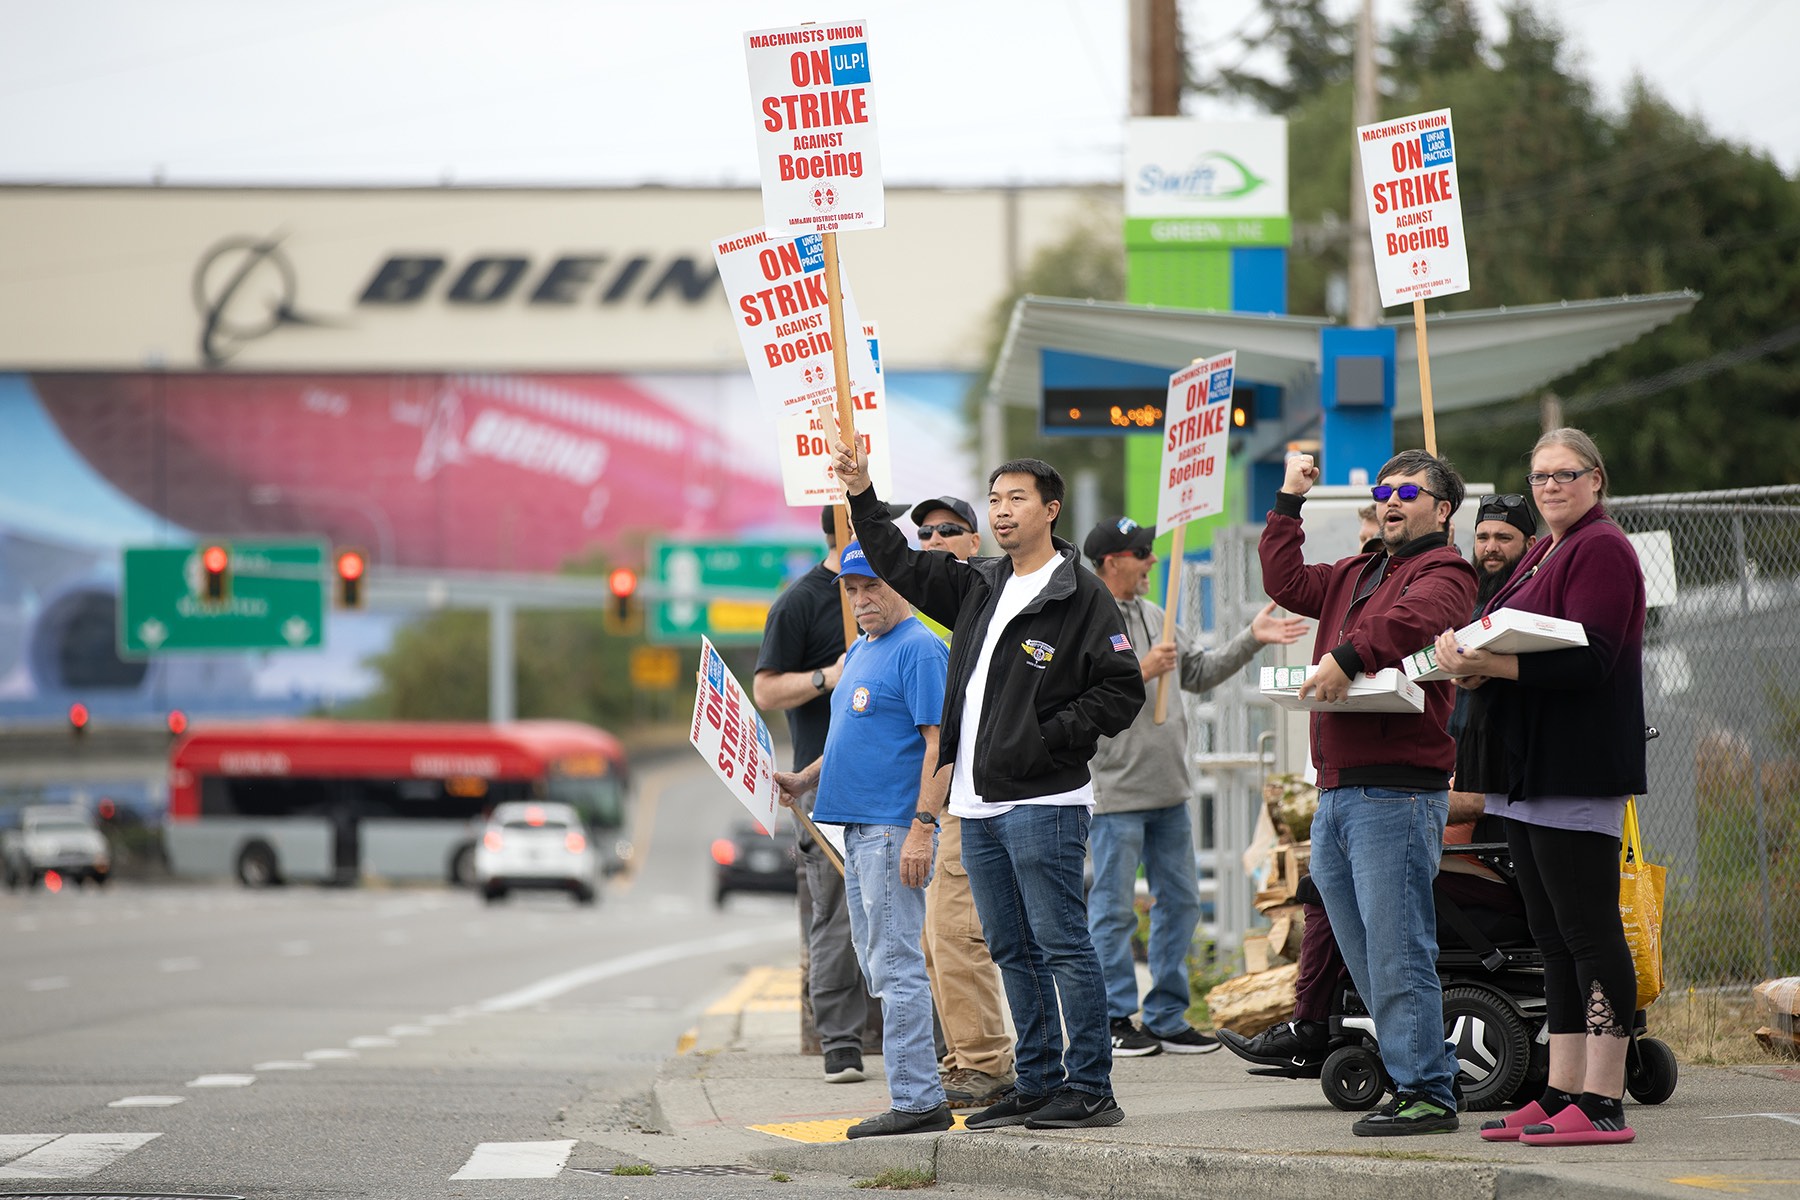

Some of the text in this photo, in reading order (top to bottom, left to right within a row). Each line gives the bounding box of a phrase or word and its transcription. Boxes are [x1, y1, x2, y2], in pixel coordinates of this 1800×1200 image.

[750, 25, 863, 48] MACHINISTS UNION
[790, 49, 832, 88] ON
[834, 52, 865, 71] ULP!
[762, 88, 868, 132] STRIKE
[793, 132, 843, 151] AGAINST
[1362, 115, 1447, 142] MACHINISTS UNION
[1425, 130, 1446, 143] UNFAIR
[1391, 138, 1423, 173] ON
[1423, 148, 1452, 162] PRACTICES!
[1428, 140, 1446, 152] LABOR
[778, 150, 863, 181] Boeing
[1136, 164, 1216, 196] Swift
[1373, 170, 1452, 214] STRIKE
[812, 214, 837, 223] DISTRICT
[837, 213, 854, 221] LODGE
[816, 222, 839, 231] AFL-CIO
[1151, 221, 1221, 242] GREEN
[1396, 209, 1433, 228] AGAINST
[718, 231, 775, 255] MACHINI
[805, 243, 824, 255] LABO
[1386, 225, 1449, 256] Boeing
[759, 242, 802, 281] ON
[358, 256, 720, 303] BOEIN
[739, 272, 844, 327] STRIK
[775, 313, 823, 338] AGAINST
[763, 331, 833, 368] Boein
[1172, 356, 1233, 388] MACHINISTS UNION
[806, 387, 830, 400] DISTRICT
[811, 394, 833, 406] AFL-CIO
[1186, 379, 1209, 412] ON
[1168, 405, 1225, 453] STRIKE
[467, 409, 609, 485] BOEING
[1178, 442, 1207, 463] AGAINST
[1168, 455, 1215, 490] Boeing
[692, 642, 711, 743] MACHINISTS UNION
[706, 684, 723, 731] ON
[718, 676, 740, 779] STRIKE
[738, 718, 748, 767] AGAINST
